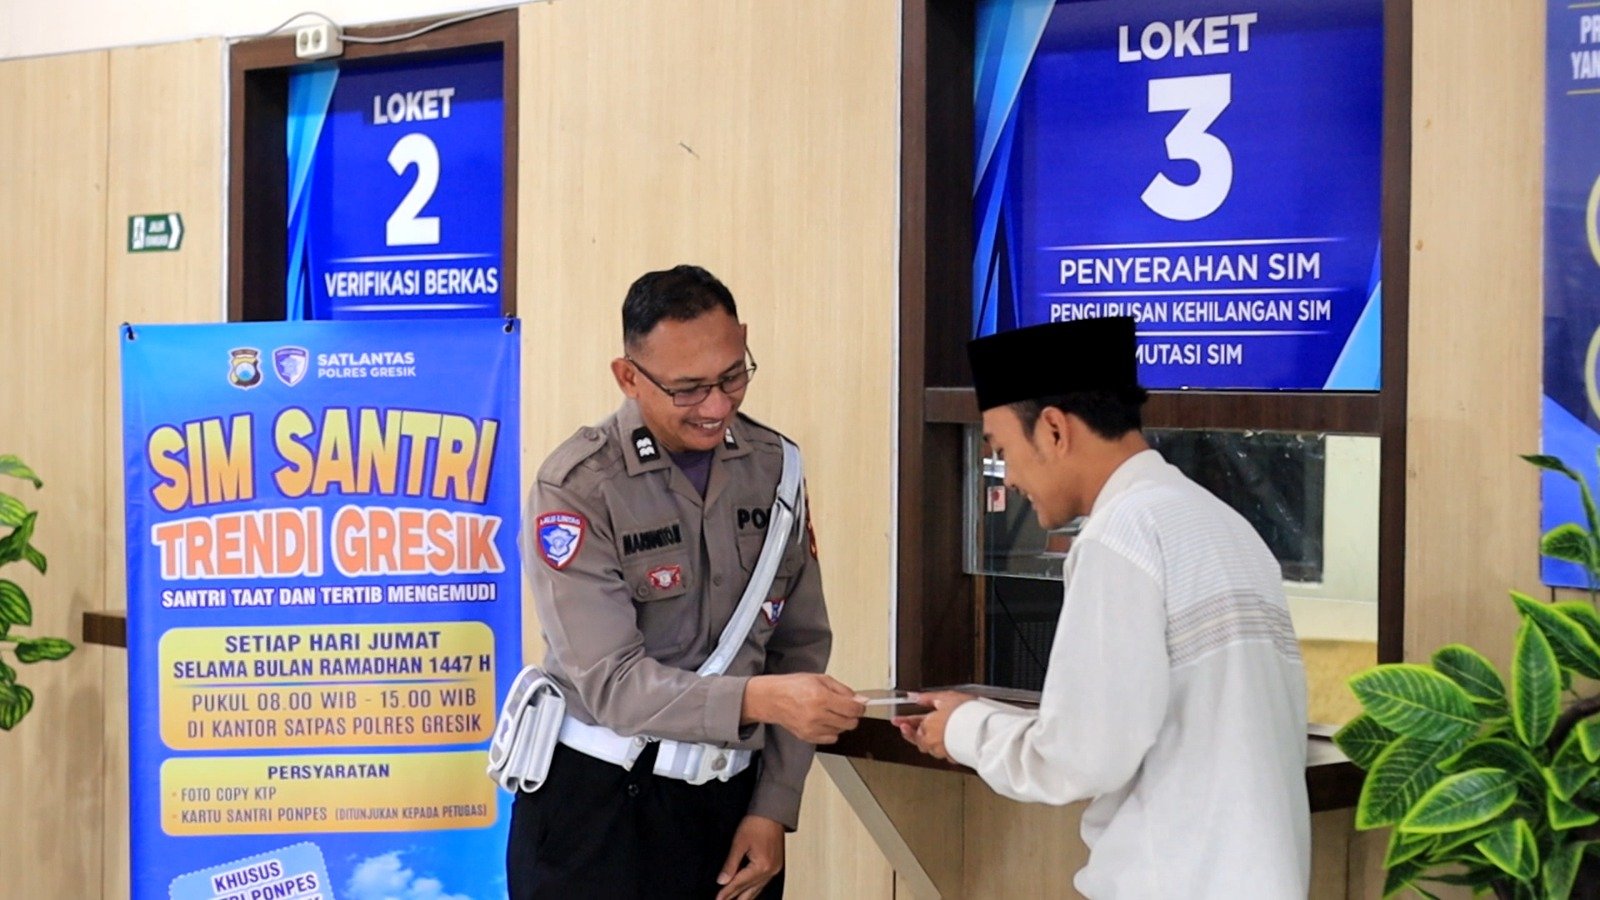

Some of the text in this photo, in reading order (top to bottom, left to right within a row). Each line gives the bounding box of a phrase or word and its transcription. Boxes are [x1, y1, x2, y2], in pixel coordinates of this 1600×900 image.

[1119, 12, 1258, 62] LOKET
[373, 88, 454, 125] LOKET
[1140, 73, 1234, 221] 3
[386, 133, 441, 247] 2
[1060, 252, 1321, 285] PENYERAHAN SIM
[324, 267, 499, 297] VERIFIKASI BERKAS
[1172, 301, 1293, 322] KEHILANGAN
[1298, 299, 1331, 321] SIM
[317, 351, 415, 366] SATLANTAS
[1207, 343, 1242, 365] SIM
[318, 366, 416, 379] POLRES GRESIK
[147, 406, 499, 512] SIM SANTRI
[153, 505, 505, 580] TRENDI GRESIK
[162, 583, 496, 609] SANTRI TAAT DAN TERTIB MENGEMUDI
[225, 631, 441, 653] SETIAP HARI JUMAT
[173, 654, 491, 679] SELAMA BULAN RAMADHAN 1447 H
[192, 693, 250, 712] PUKUL
[257, 691, 312, 711] 08.00
[320, 690, 357, 709] WIB
[380, 689, 431, 708] 15.00
[440, 688, 477, 707] WIB
[188, 713, 481, 738] DI KANTOR SATPAS POLRES GRESIK
[268, 764, 389, 780] PERSYARATAN
[181, 786, 277, 802] FOTO COPY KTP
[181, 803, 488, 824] KARTU SANTRI PONPES (DITUNJUKAN KEPADA PETUGAS)
[214, 861, 281, 892] KHUSUS
[251, 874, 317, 900] PONPES
